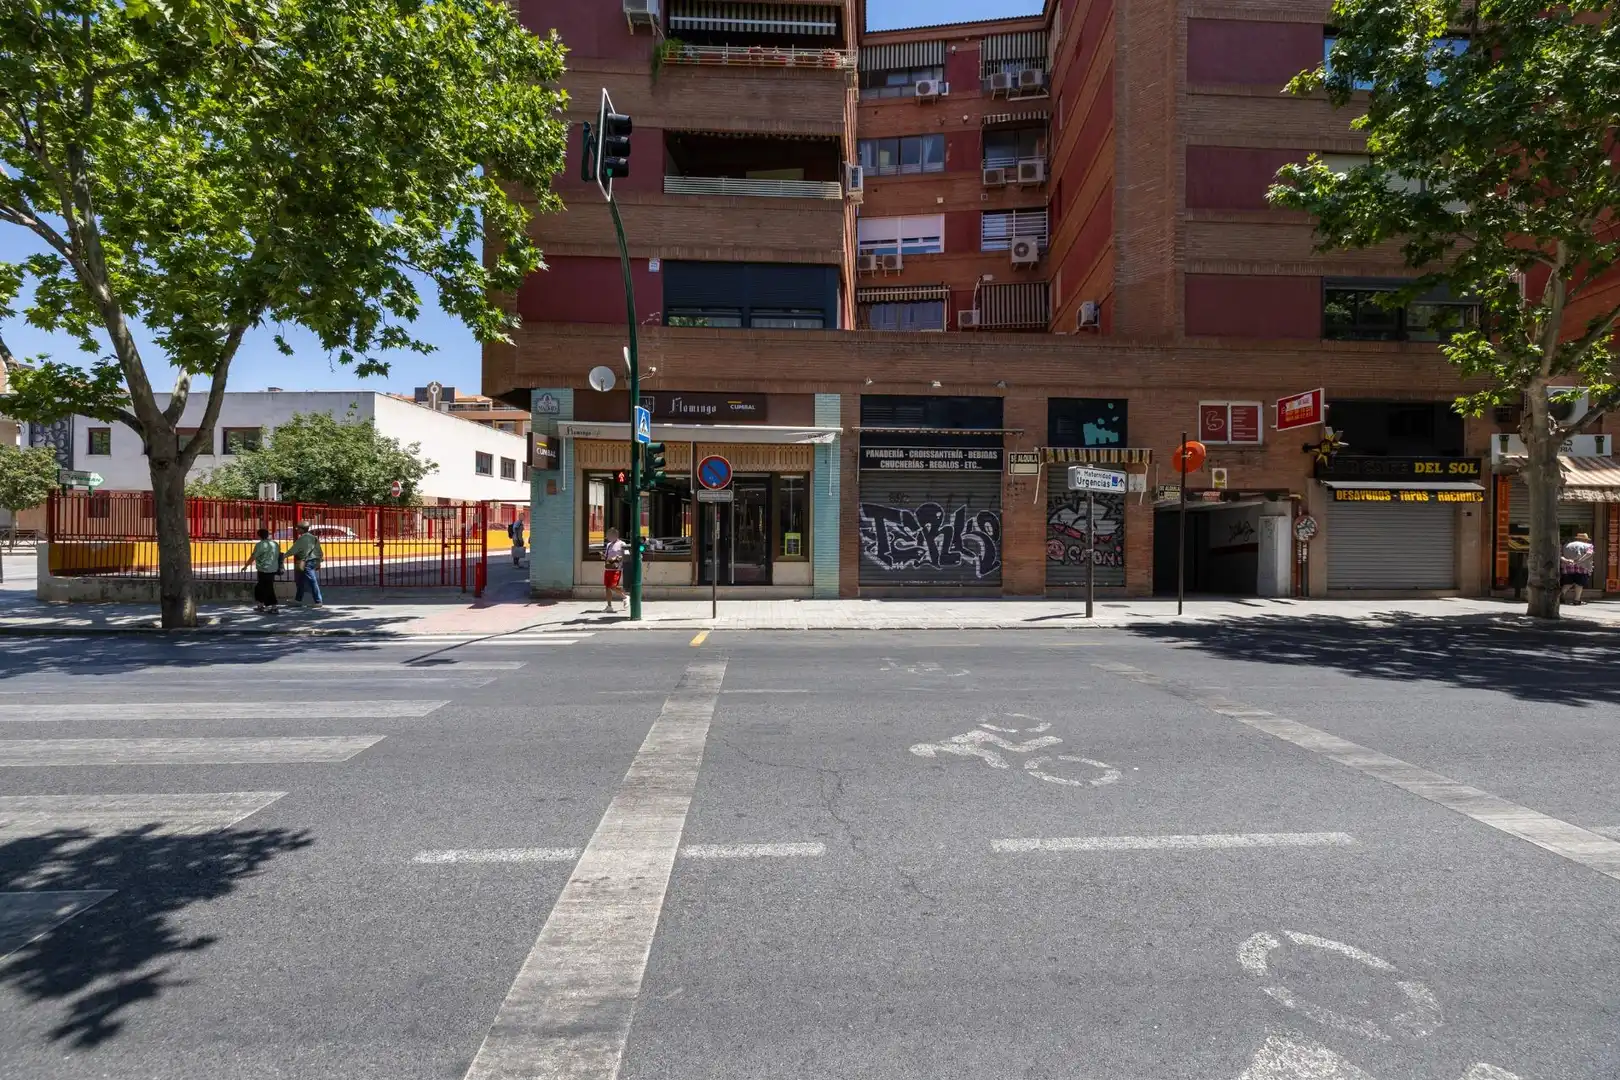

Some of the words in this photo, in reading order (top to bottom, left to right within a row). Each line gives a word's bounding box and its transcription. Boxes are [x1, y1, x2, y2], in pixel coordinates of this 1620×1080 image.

[866, 448, 904, 458] PANADERÍA
[909, 448, 963, 459] CROISSANTERÍA
[968, 450, 998, 459] BEBIDAS
[880, 459, 924, 469] CHUCHERÍAS
[929, 460, 960, 469] REGALOS
[1414, 462, 1444, 474] DEL
[1448, 462, 1478, 474] SOL
[1076, 476, 1110, 488] Urgencias
[1400, 490, 1429, 502] TAPAS
